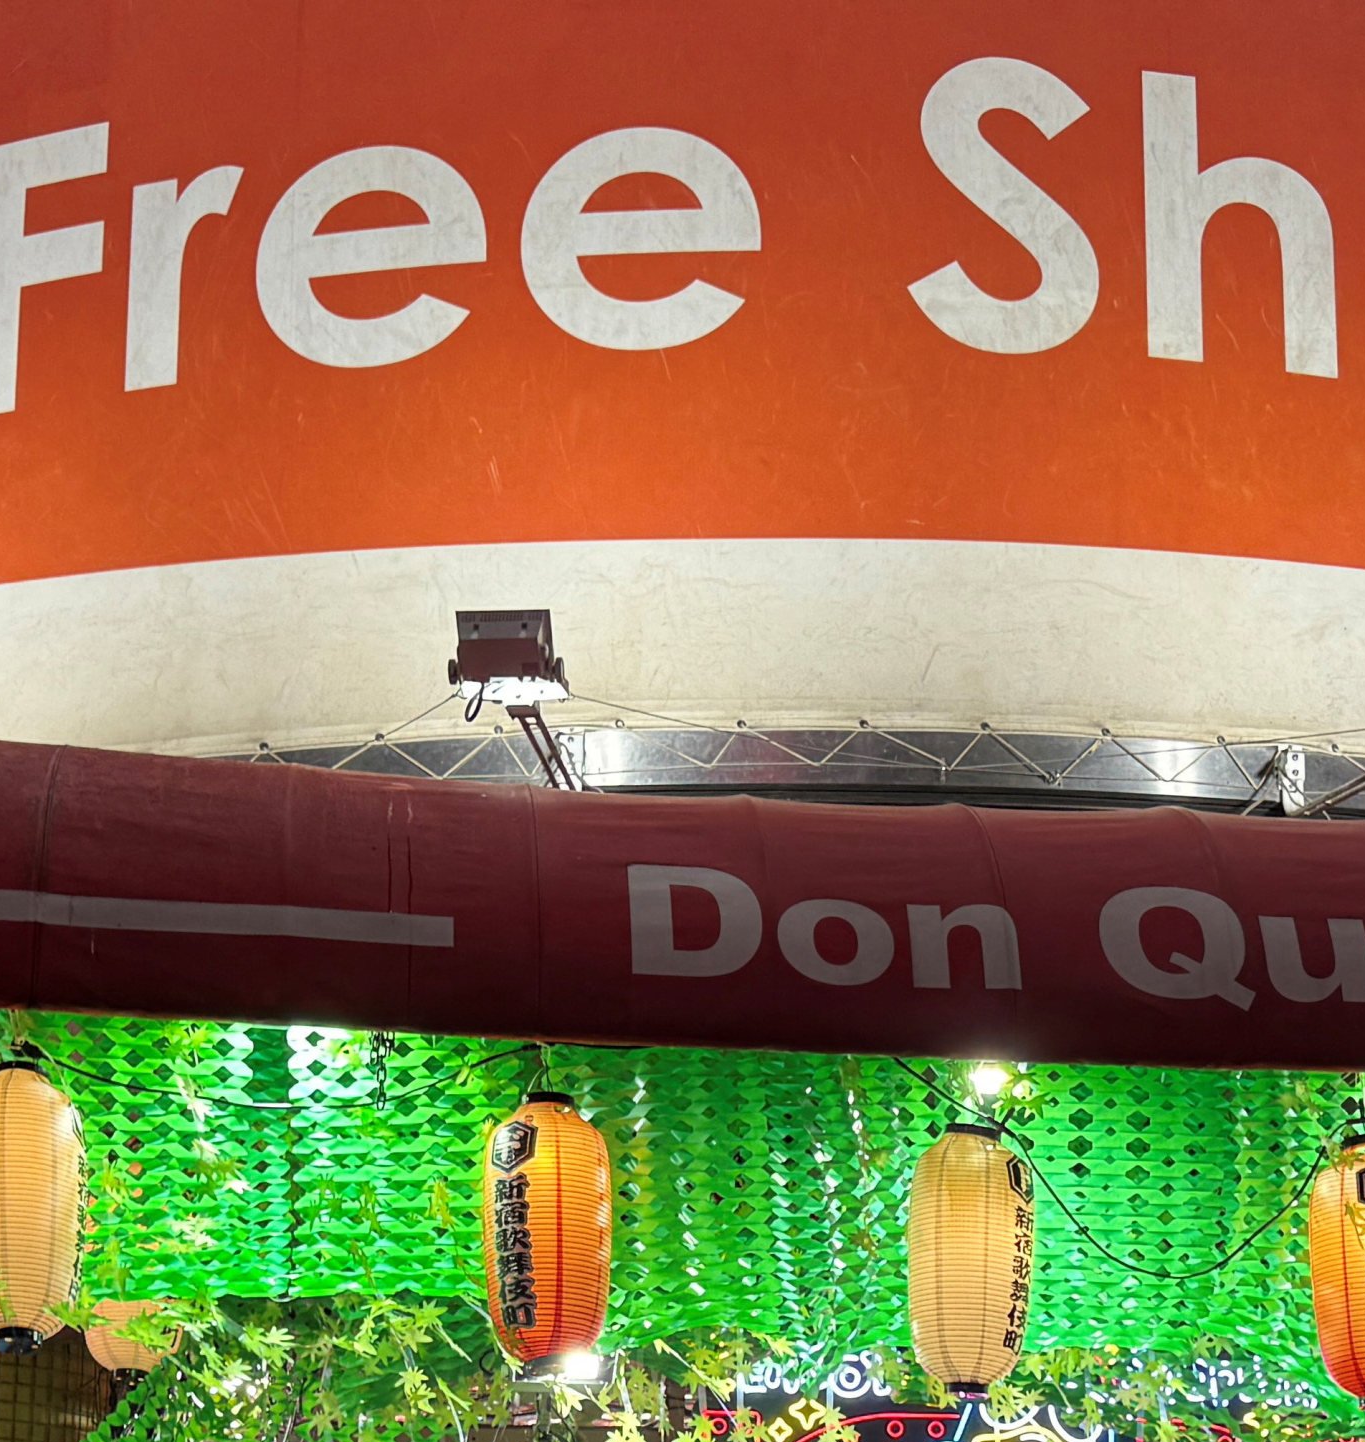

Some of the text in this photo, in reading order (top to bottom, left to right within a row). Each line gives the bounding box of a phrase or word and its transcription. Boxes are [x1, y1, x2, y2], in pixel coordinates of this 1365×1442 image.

[628, 862, 1022, 991] Don
[494, 1175, 537, 1330] 新宿歌舞伎町
